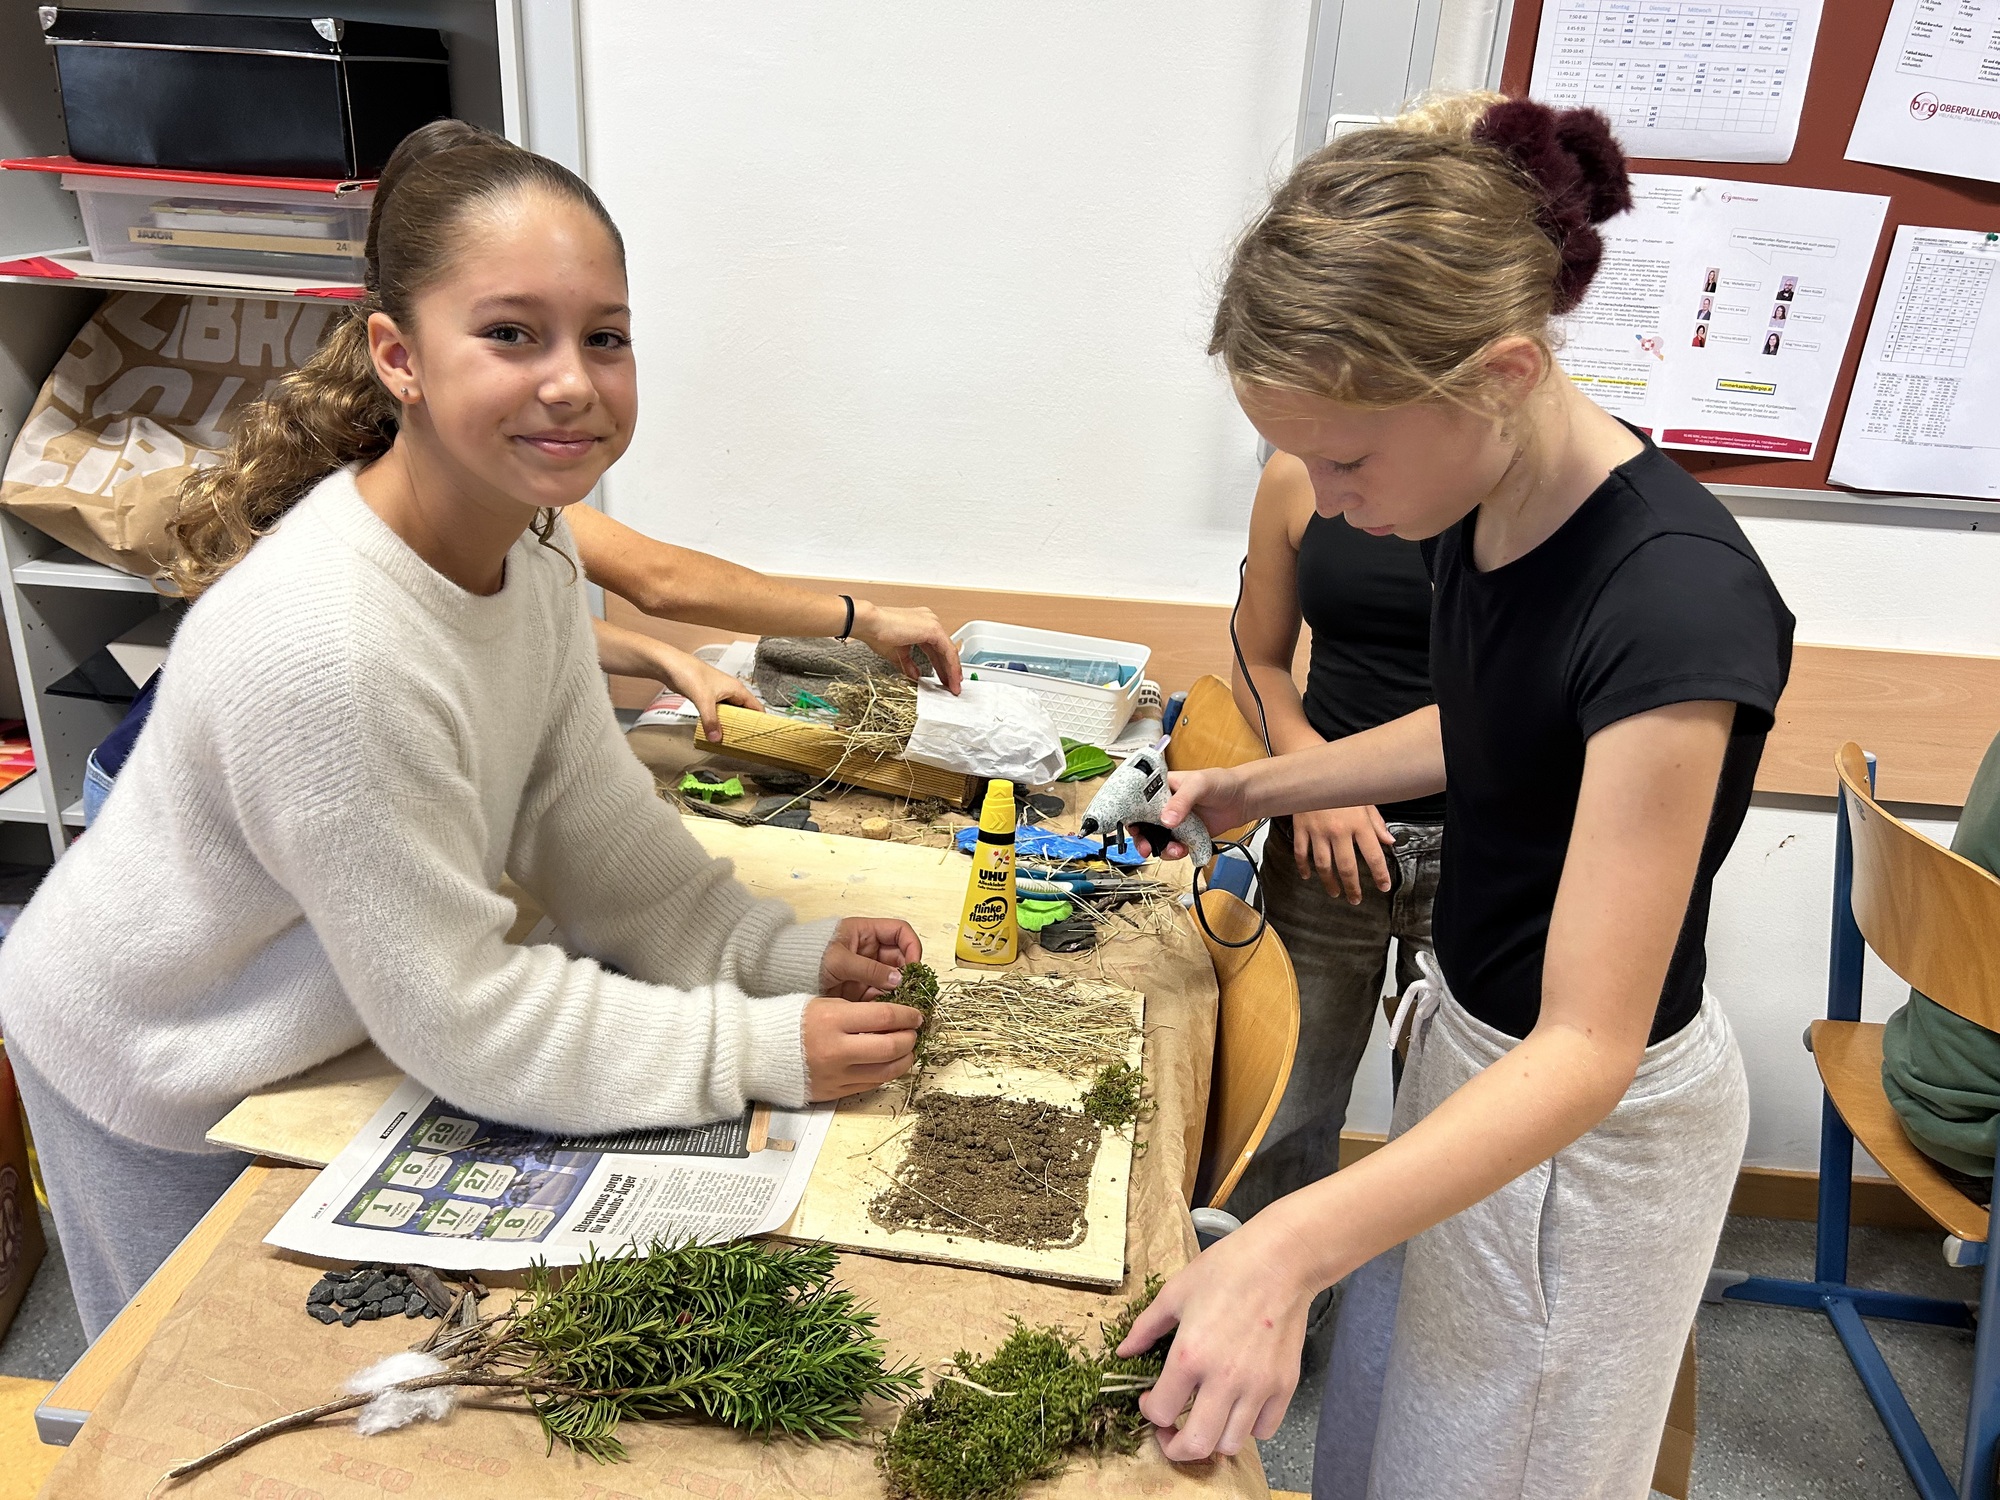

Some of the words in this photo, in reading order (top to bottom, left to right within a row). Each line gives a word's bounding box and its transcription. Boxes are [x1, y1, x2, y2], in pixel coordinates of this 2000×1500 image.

[1610, 3, 1630, 11] Montag
[1725, 8, 1754, 16] Donnerstag
[1939, 103, 2000, 120] OBERPULLEND
[136, 229, 174, 241] JAXON
[335, 242, 348, 251] 24
[979, 868, 1008, 882] UHU
[974, 902, 1002, 914] flinke
[969, 911, 1006, 922] flasche
[427, 1122, 454, 1144] 29
[390, 1160, 401, 1172] JAN
[402, 1163, 423, 1175] 6
[455, 1172, 464, 1182] MAI
[463, 1168, 490, 1190] 27
[358, 1199, 370, 1210] JAN
[572, 1194, 610, 1233] Elternbonus
[604, 1174, 623, 1193] sorgt
[596, 1176, 637, 1224] Urlaubs-Ärger
[372, 1203, 394, 1213] 1
[427, 1209, 437, 1220] MAI
[437, 1207, 460, 1226] 17
[491, 1217, 502, 1227] DEZ
[504, 1218, 525, 1229] 8
[588, 1225, 606, 1233] für
[419, 1443, 511, 1478] OBI
[319, 1451, 414, 1494] OBI
